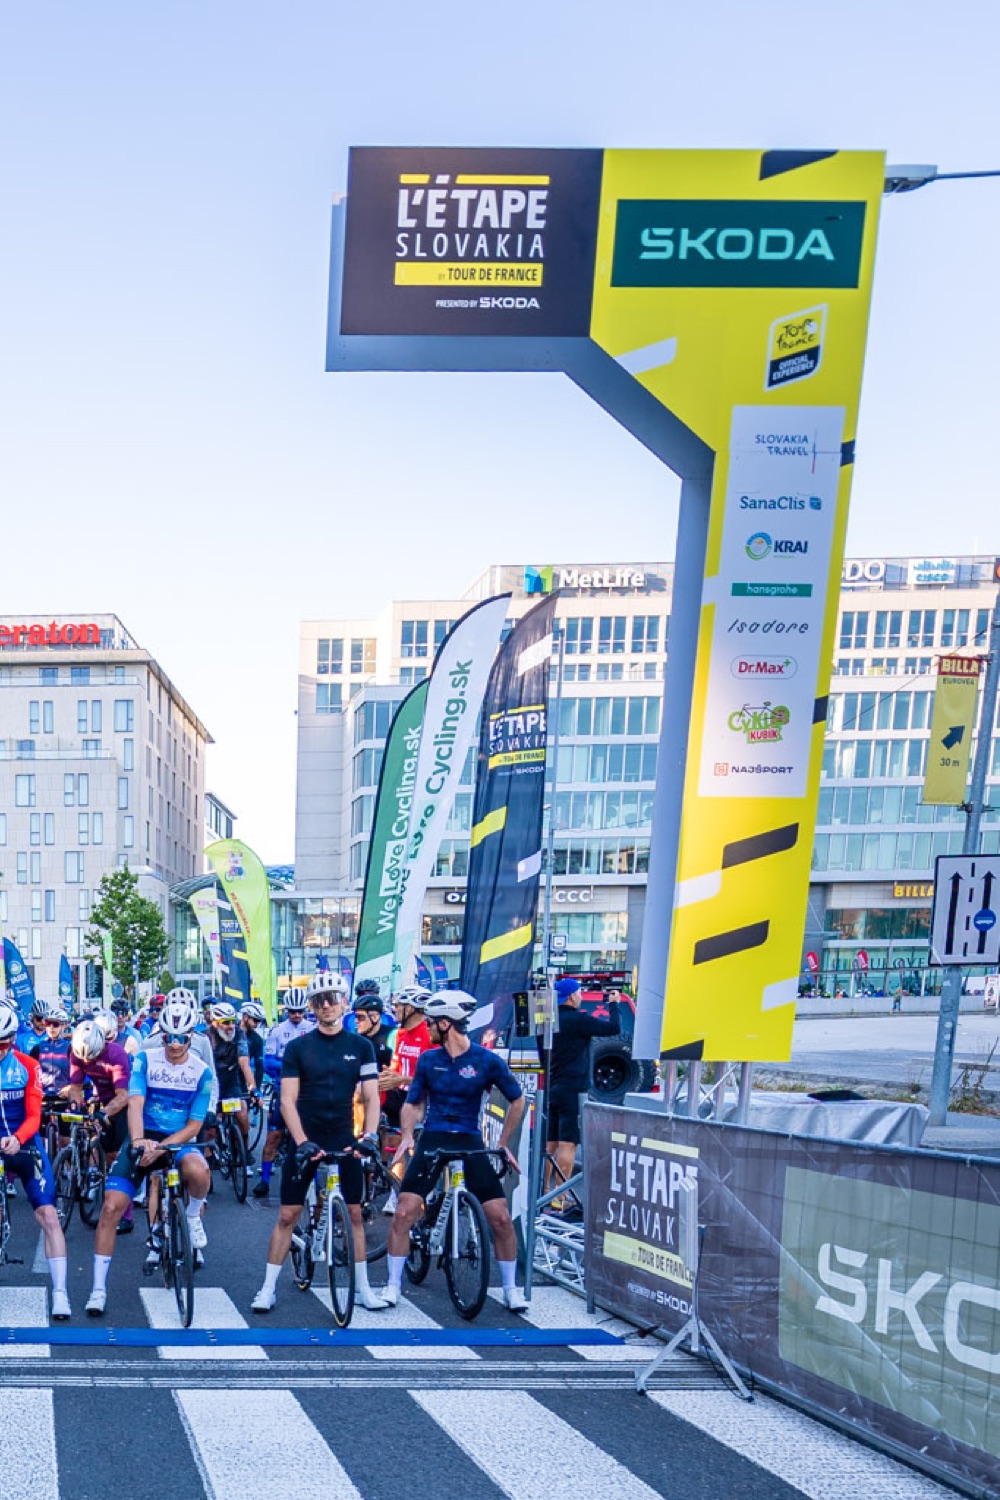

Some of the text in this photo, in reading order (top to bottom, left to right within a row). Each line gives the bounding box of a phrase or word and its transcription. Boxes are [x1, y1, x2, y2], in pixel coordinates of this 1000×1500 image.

[395, 232, 544, 258] SLOVAKIA
[448, 267, 477, 281] TOUR
[479, 267, 492, 281] DE
[495, 268, 538, 281] FRANCE
[755, 434, 809, 444] SLOVAKIA
[767, 446, 809, 456] TRAVEL
[740, 495, 805, 510] SanaClis
[773, 540, 809, 553] KRAJ
[558, 569, 645, 588] MetLife
[842, 560, 885, 581] DO
[941, 658, 979, 673] BILLA
[425, 659, 472, 795] Cycling.sk
[377, 896, 397, 935] We
[605, 1198, 675, 1245] SLOVAK
[638, 1246, 655, 1268] TOUR
[655, 1253, 665, 1272] DE
